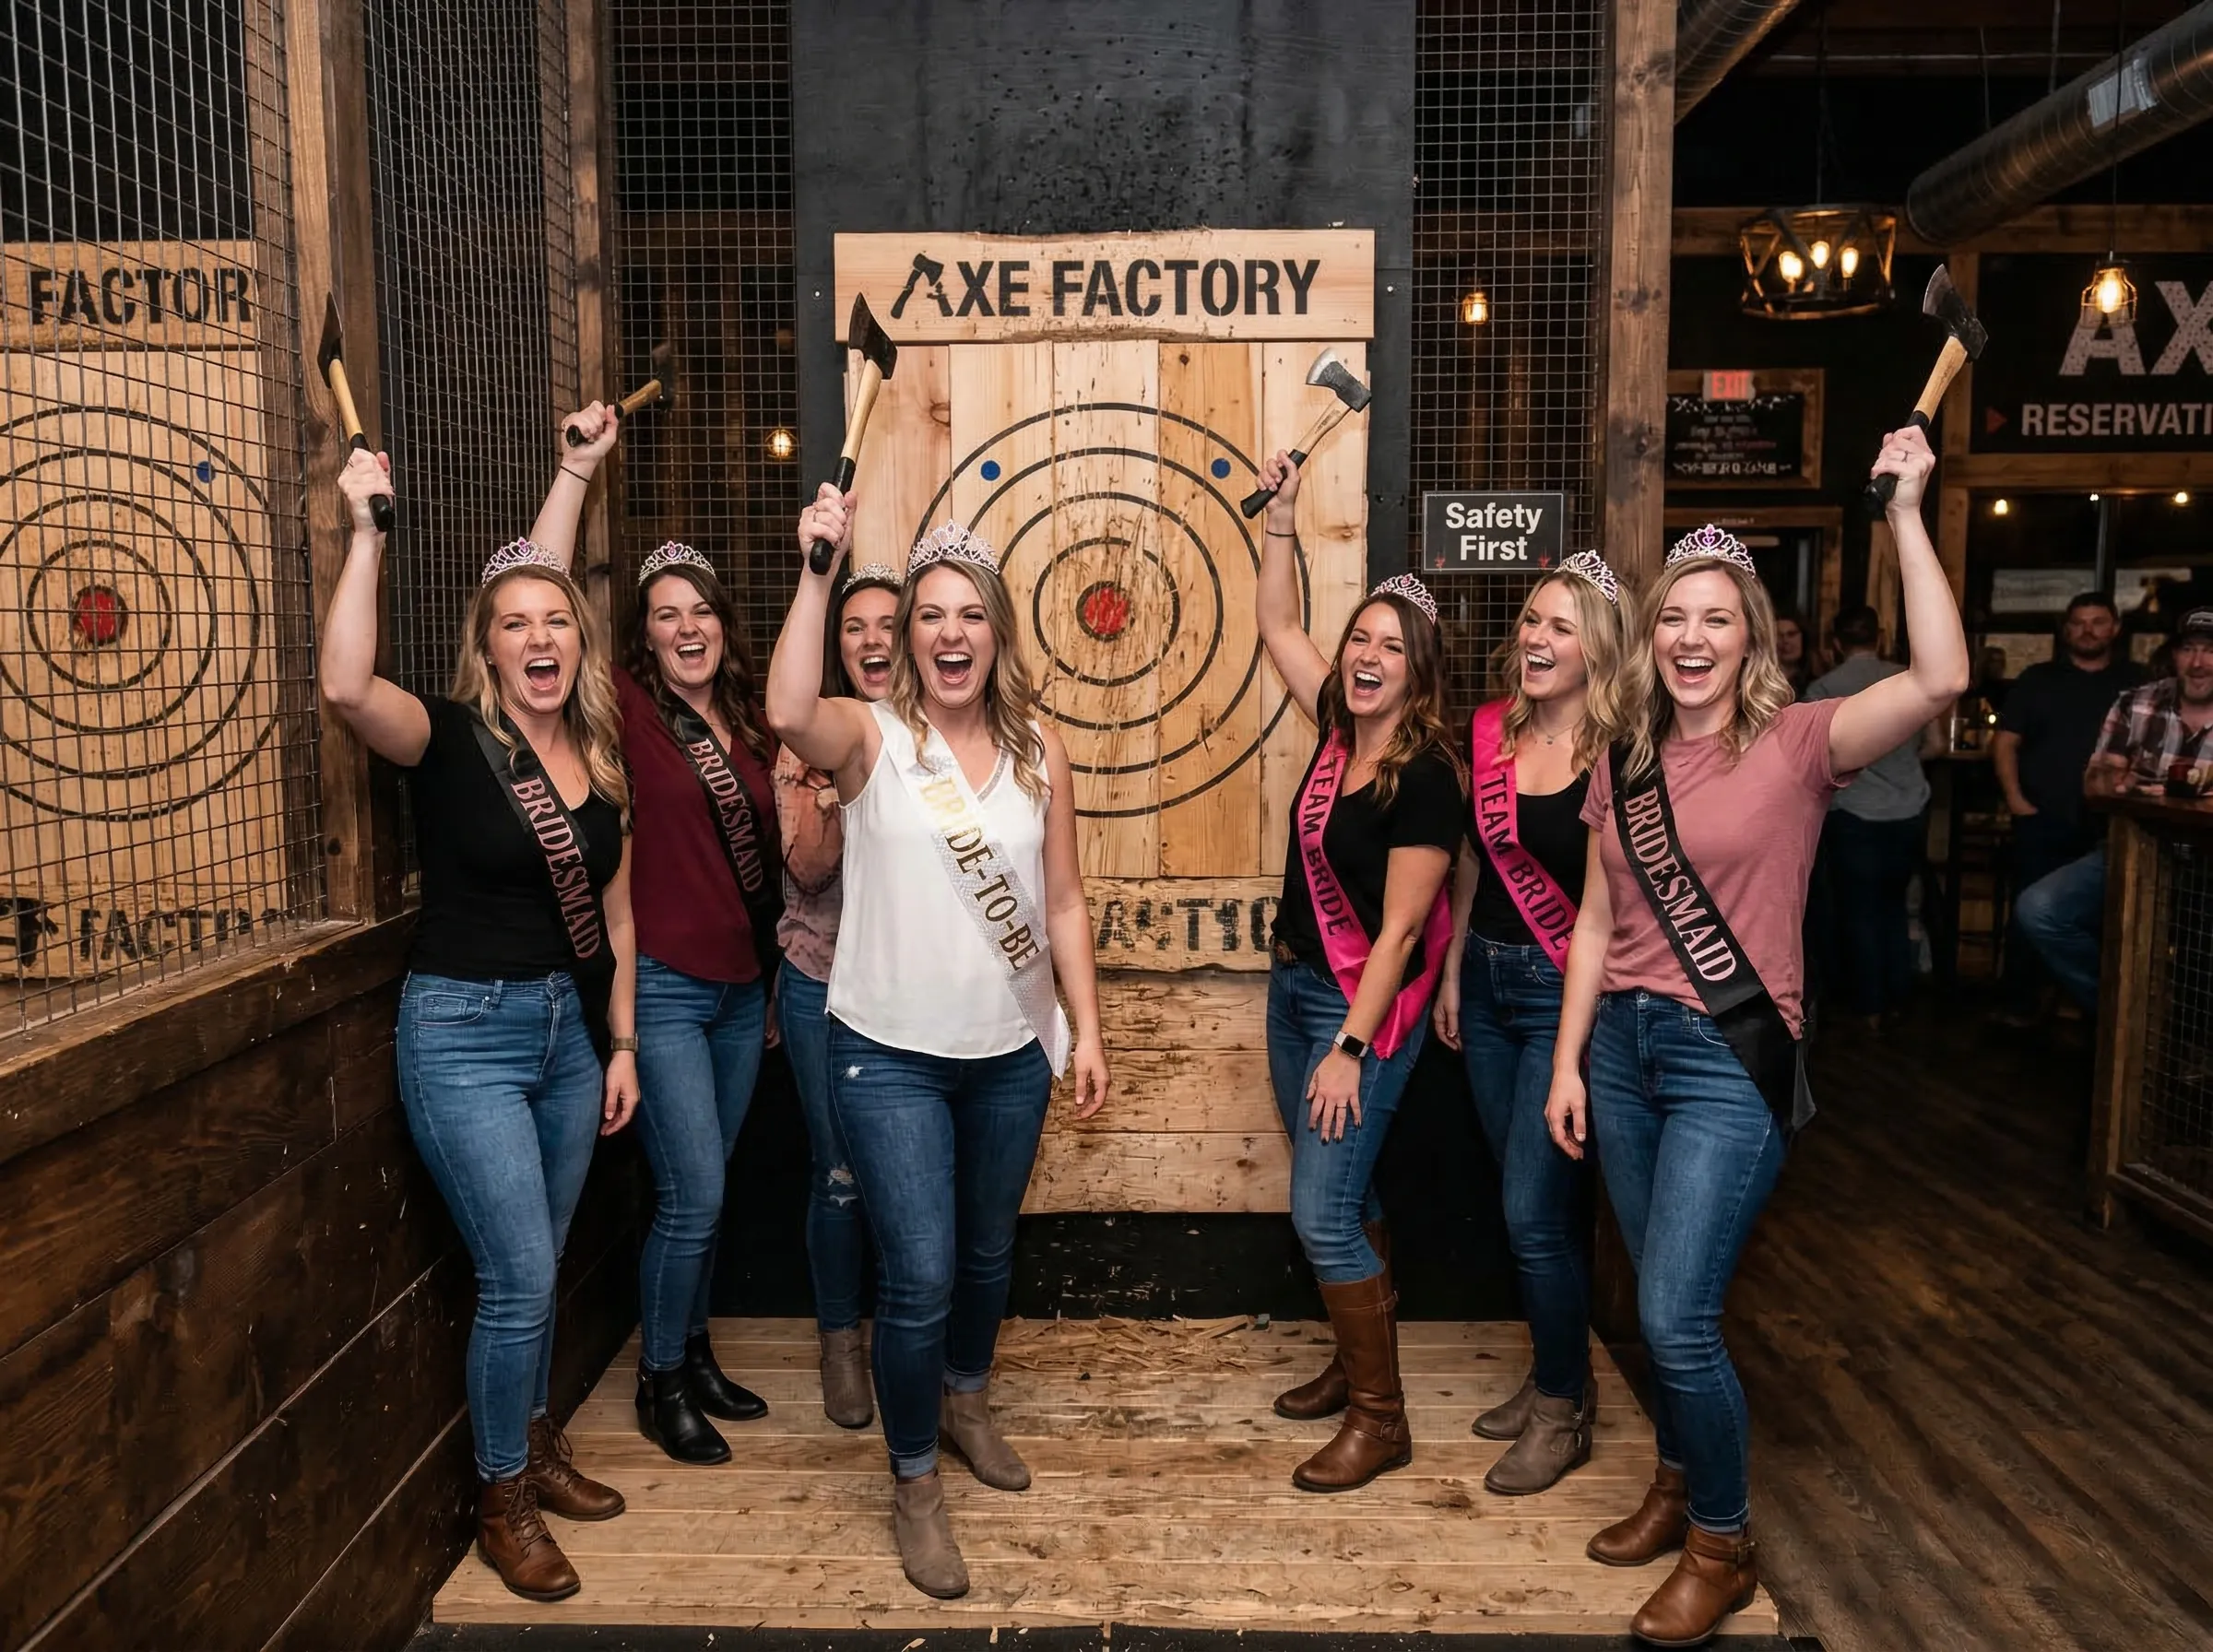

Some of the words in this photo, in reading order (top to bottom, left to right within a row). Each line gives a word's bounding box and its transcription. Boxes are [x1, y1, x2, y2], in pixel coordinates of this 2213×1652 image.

[30, 267, 253, 326] FACTOR
[1052, 258, 1320, 318] FACTORY
[1445, 502, 1544, 535] Safety
[1460, 535, 1529, 561] First
[686, 738, 764, 893] BRIDESMAID
[1302, 753, 1339, 837] TEAM
[510, 775, 601, 960] BRIDESMAID
[1306, 845, 1355, 938] BRIDE
[1480, 771, 1512, 858] TEAM
[1508, 858, 1576, 950] BRIDE
[1624, 785, 1737, 982] BRIDESMAID
